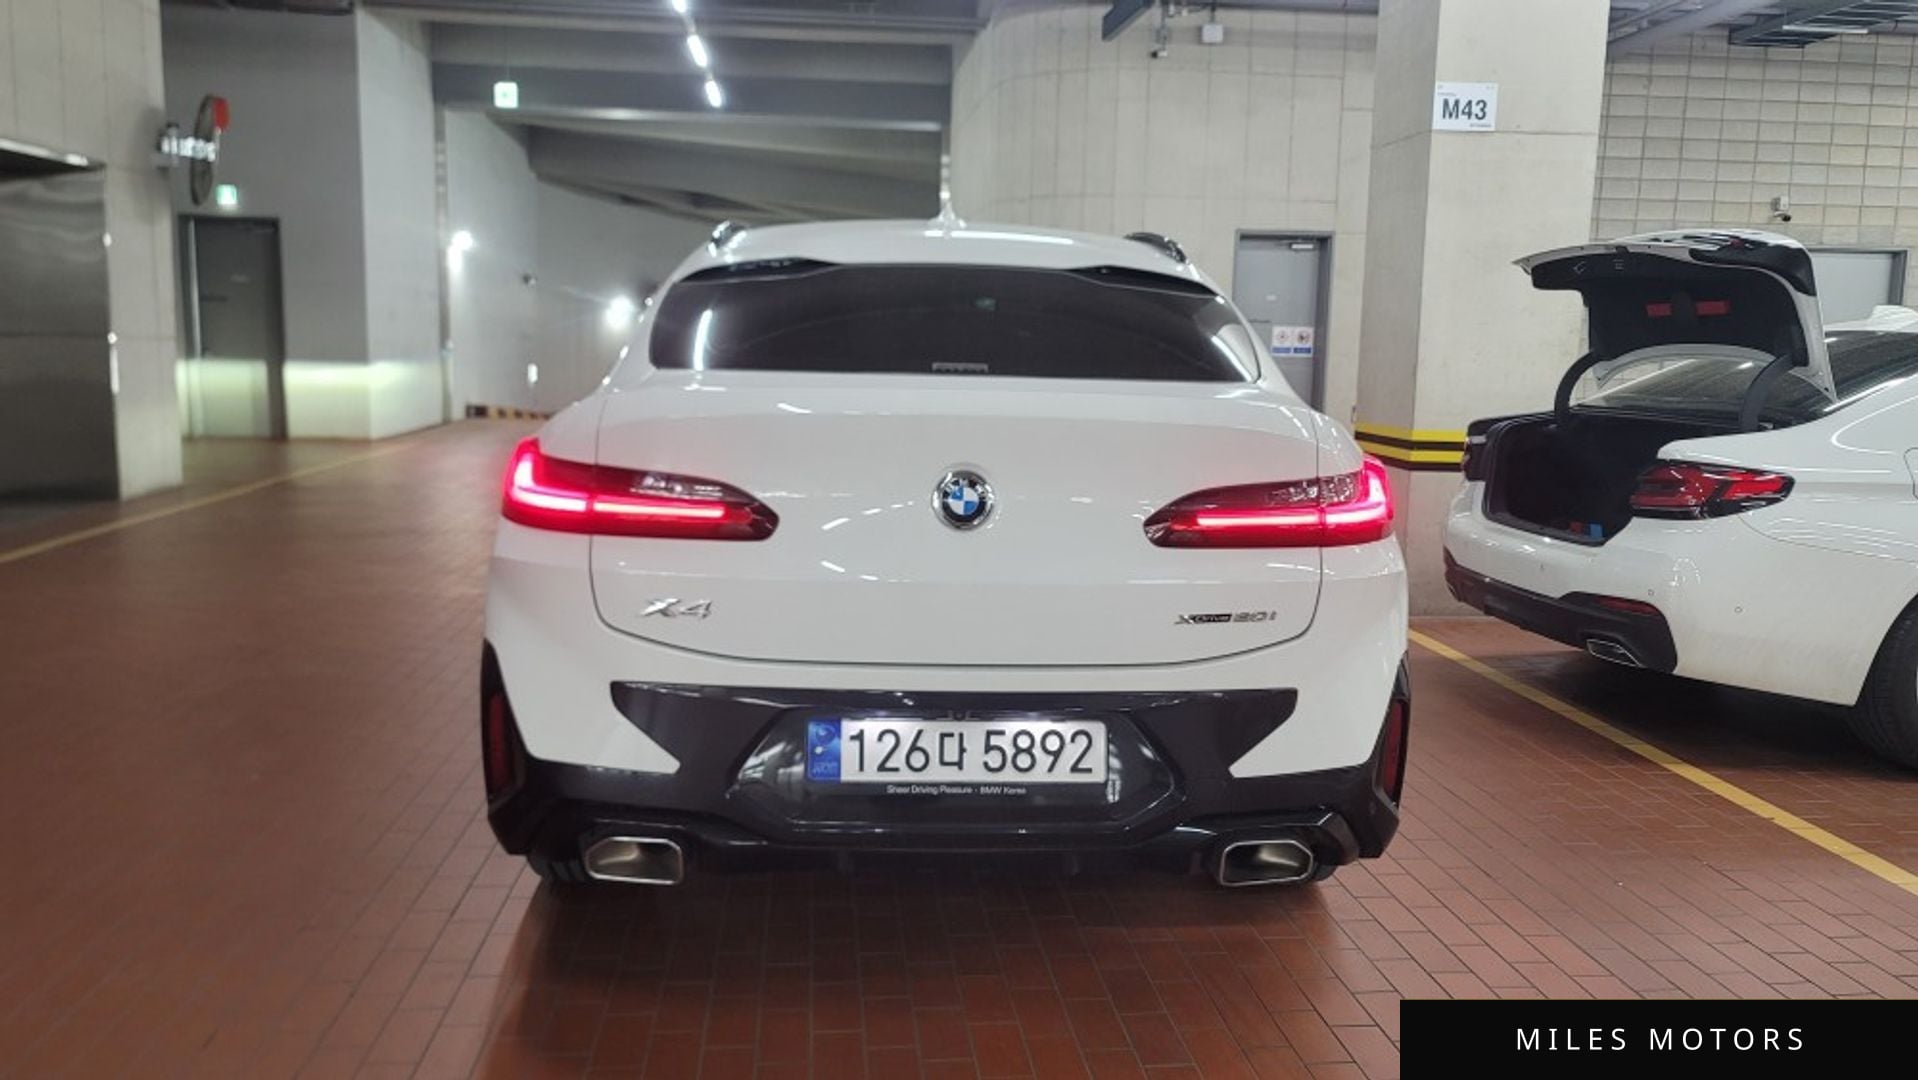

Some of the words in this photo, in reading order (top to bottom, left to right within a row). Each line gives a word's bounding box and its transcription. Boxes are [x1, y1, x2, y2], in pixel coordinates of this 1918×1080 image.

[1442, 98, 1488, 121] M43
[641, 597, 713, 620] X4
[849, 728, 967, 773] 126다
[982, 728, 1093, 774] 5892
[886, 784, 910, 794] Sheer
[911, 784, 939, 796] Driving
[940, 784, 973, 794] Pleasure
[980, 785, 1002, 795] BMW
